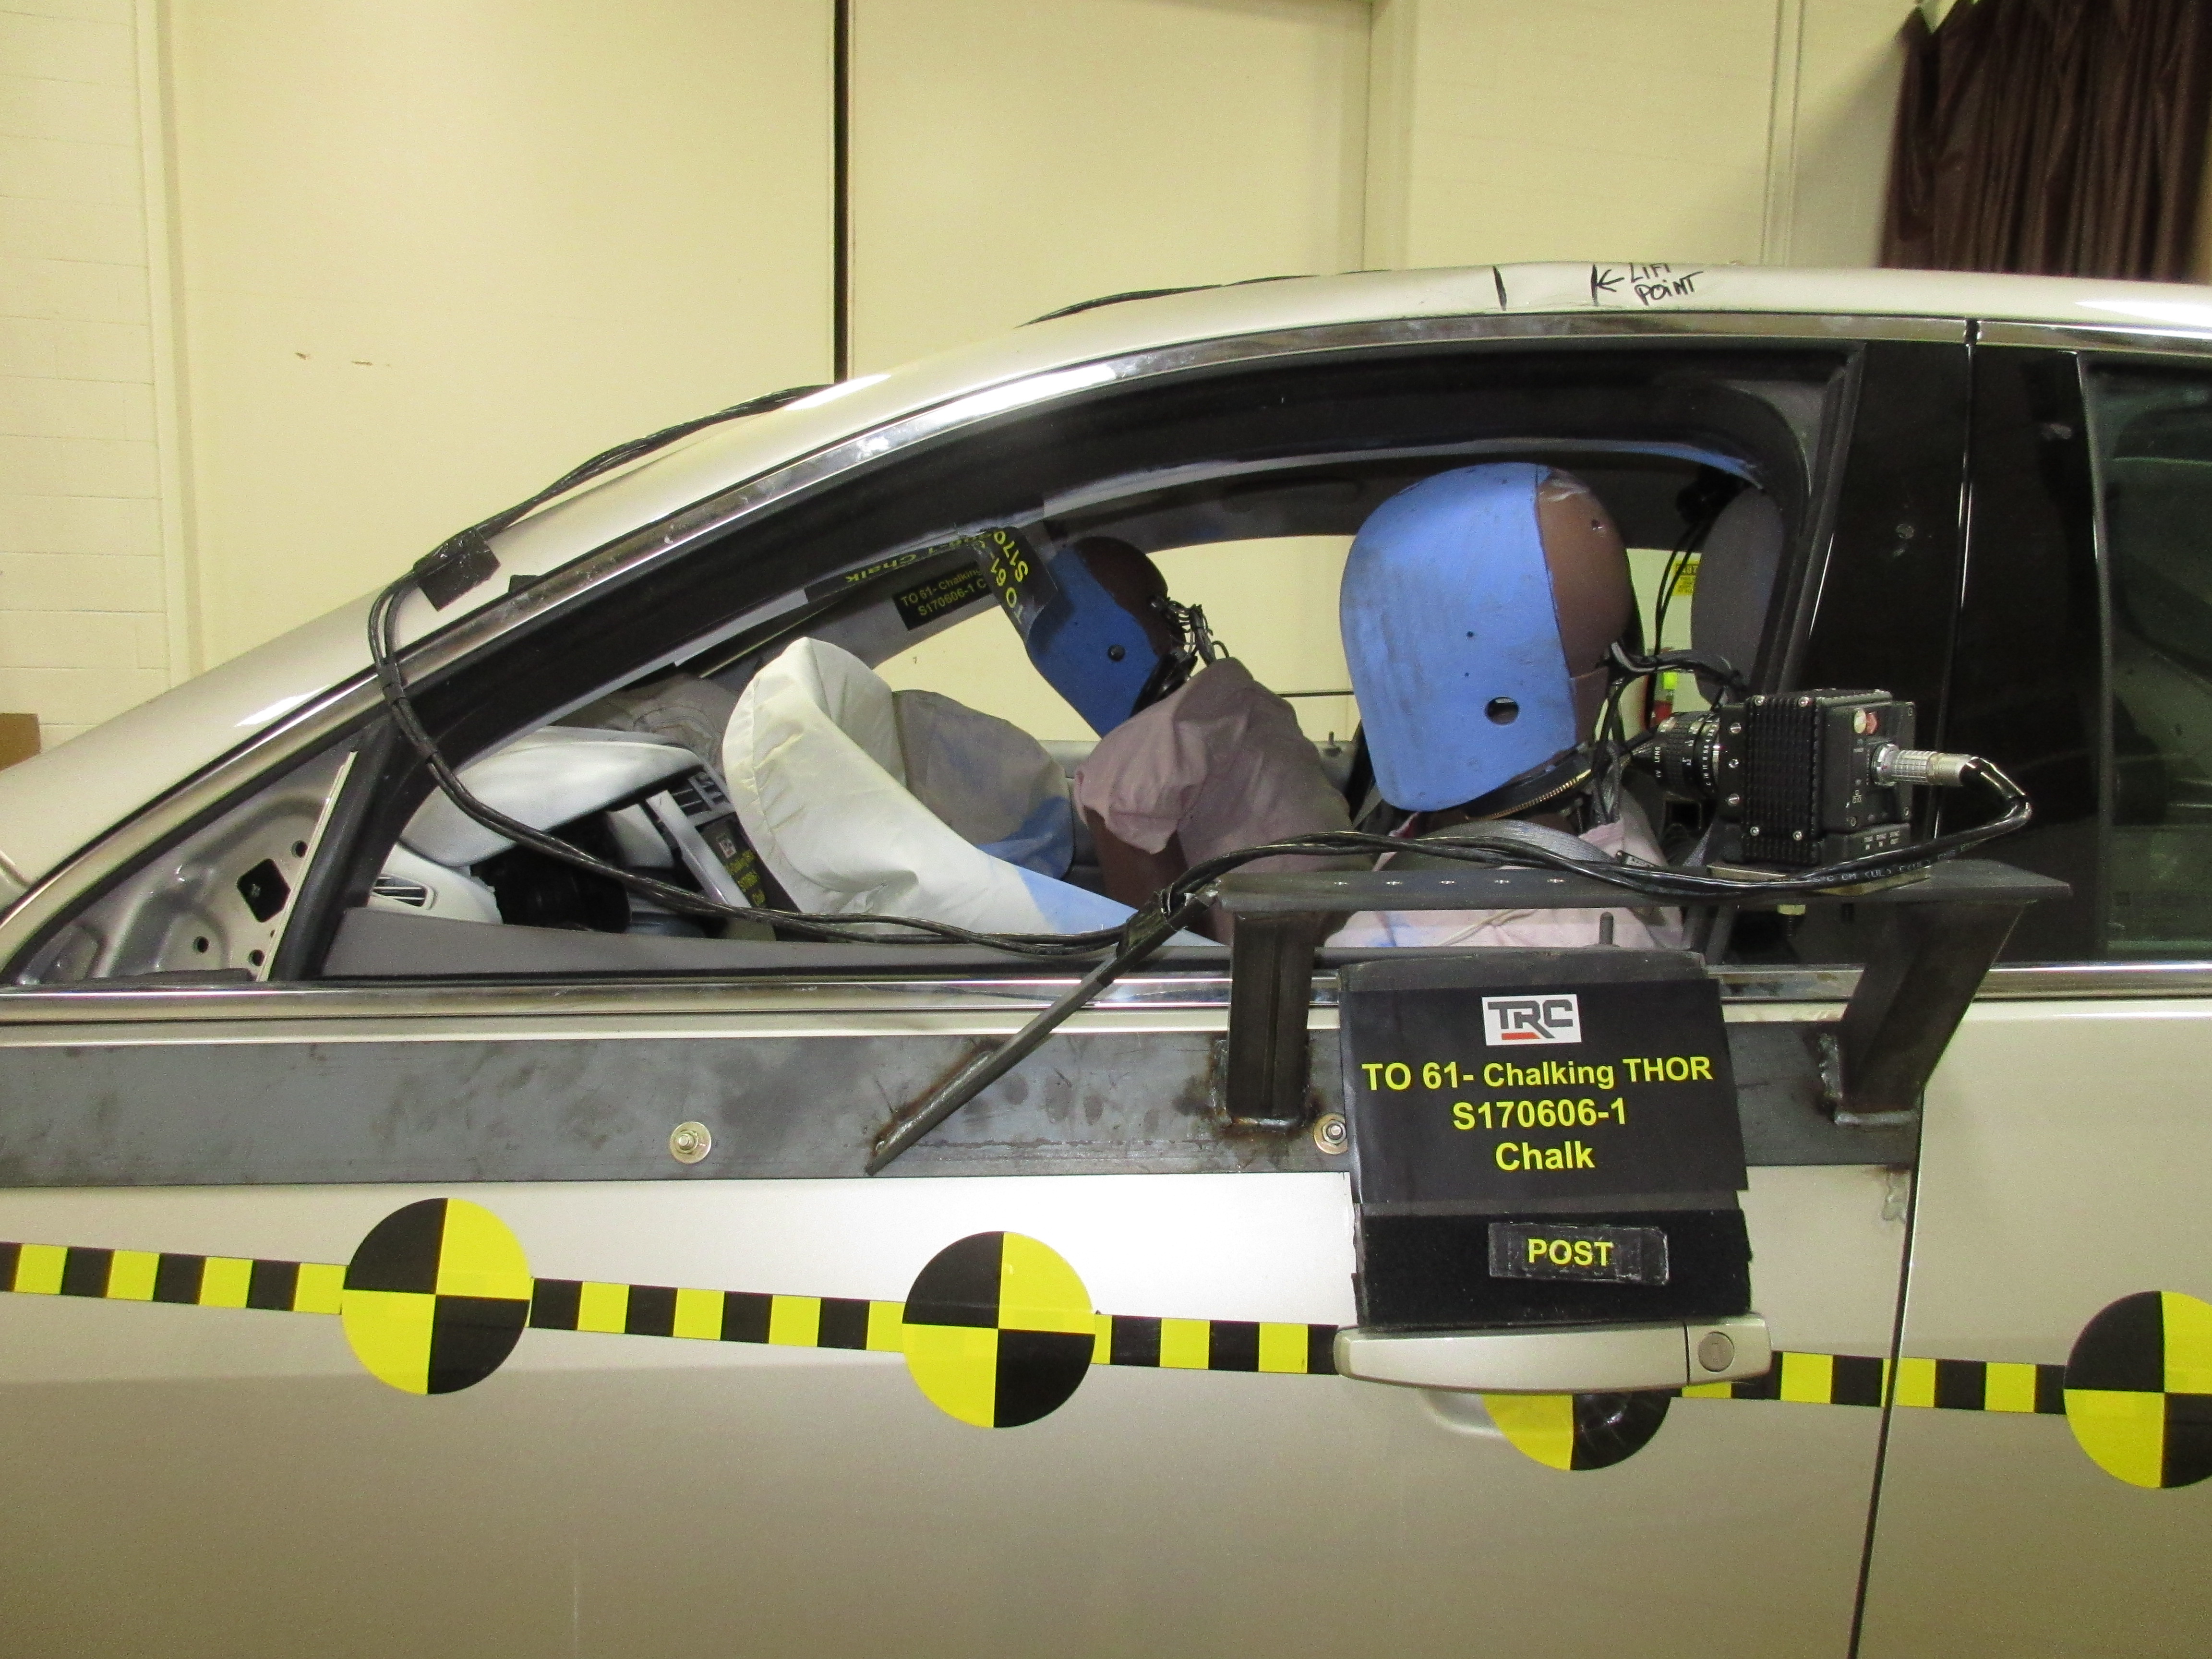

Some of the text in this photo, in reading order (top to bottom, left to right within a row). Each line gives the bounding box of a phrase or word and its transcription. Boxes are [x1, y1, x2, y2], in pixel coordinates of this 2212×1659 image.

[900, 592, 918, 607] TO
[1488, 999, 1574, 1039] TRC
[1362, 1057, 1714, 1090] TO 61- Chalking THOR
[1453, 1097, 1625, 1130] S170606-1
[1495, 1142, 1596, 1171] Chalk
[1528, 1238, 1613, 1267] POST
